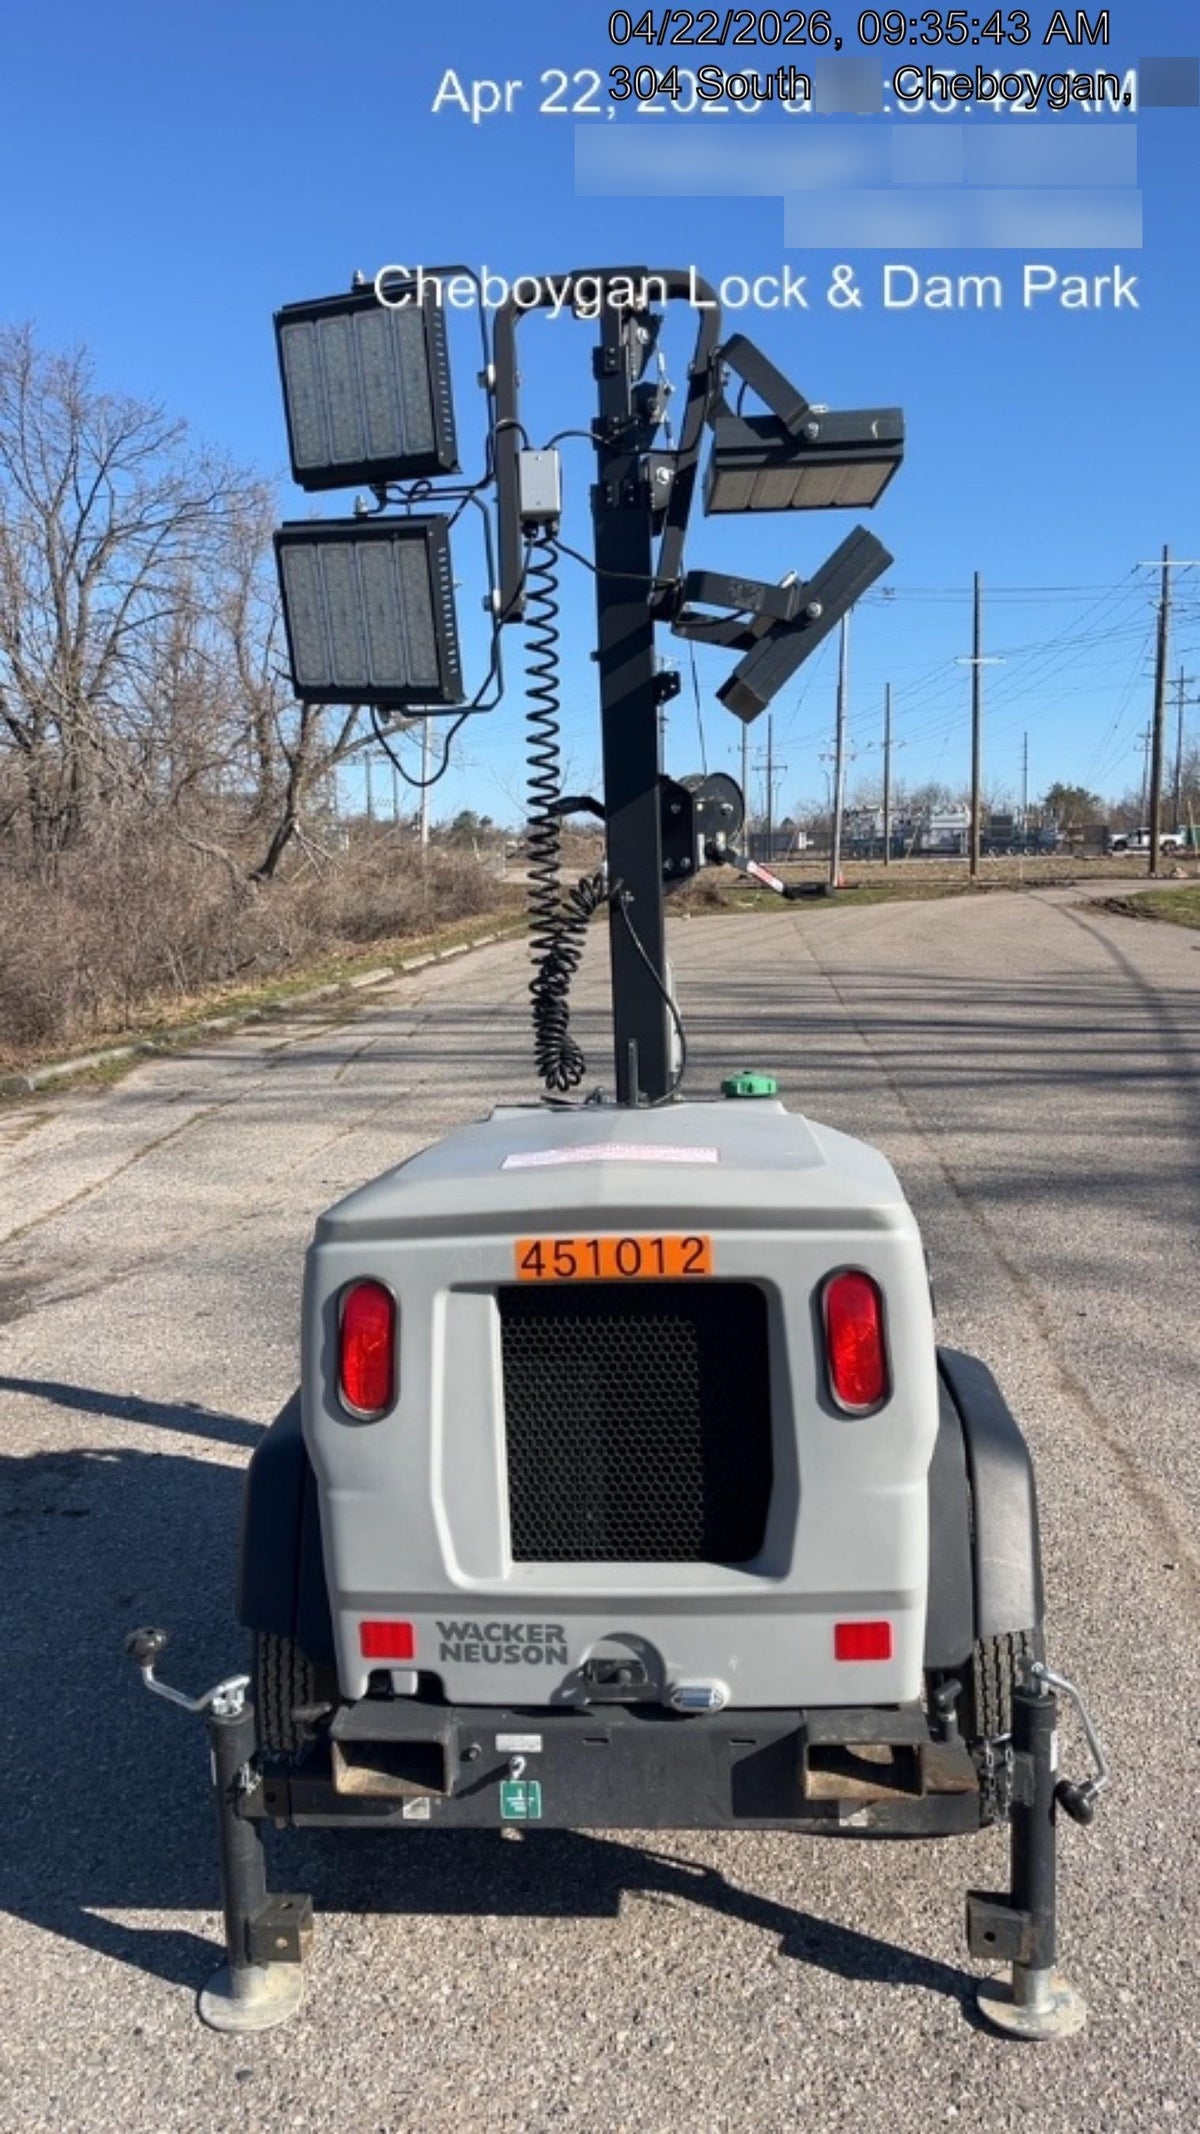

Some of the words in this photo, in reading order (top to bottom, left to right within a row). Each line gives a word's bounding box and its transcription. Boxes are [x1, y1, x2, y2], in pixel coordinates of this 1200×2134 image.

[521, 1236, 706, 1277] 451012
[436, 1621, 567, 1643] WACKER
[440, 1643, 568, 1665] NEUSON
